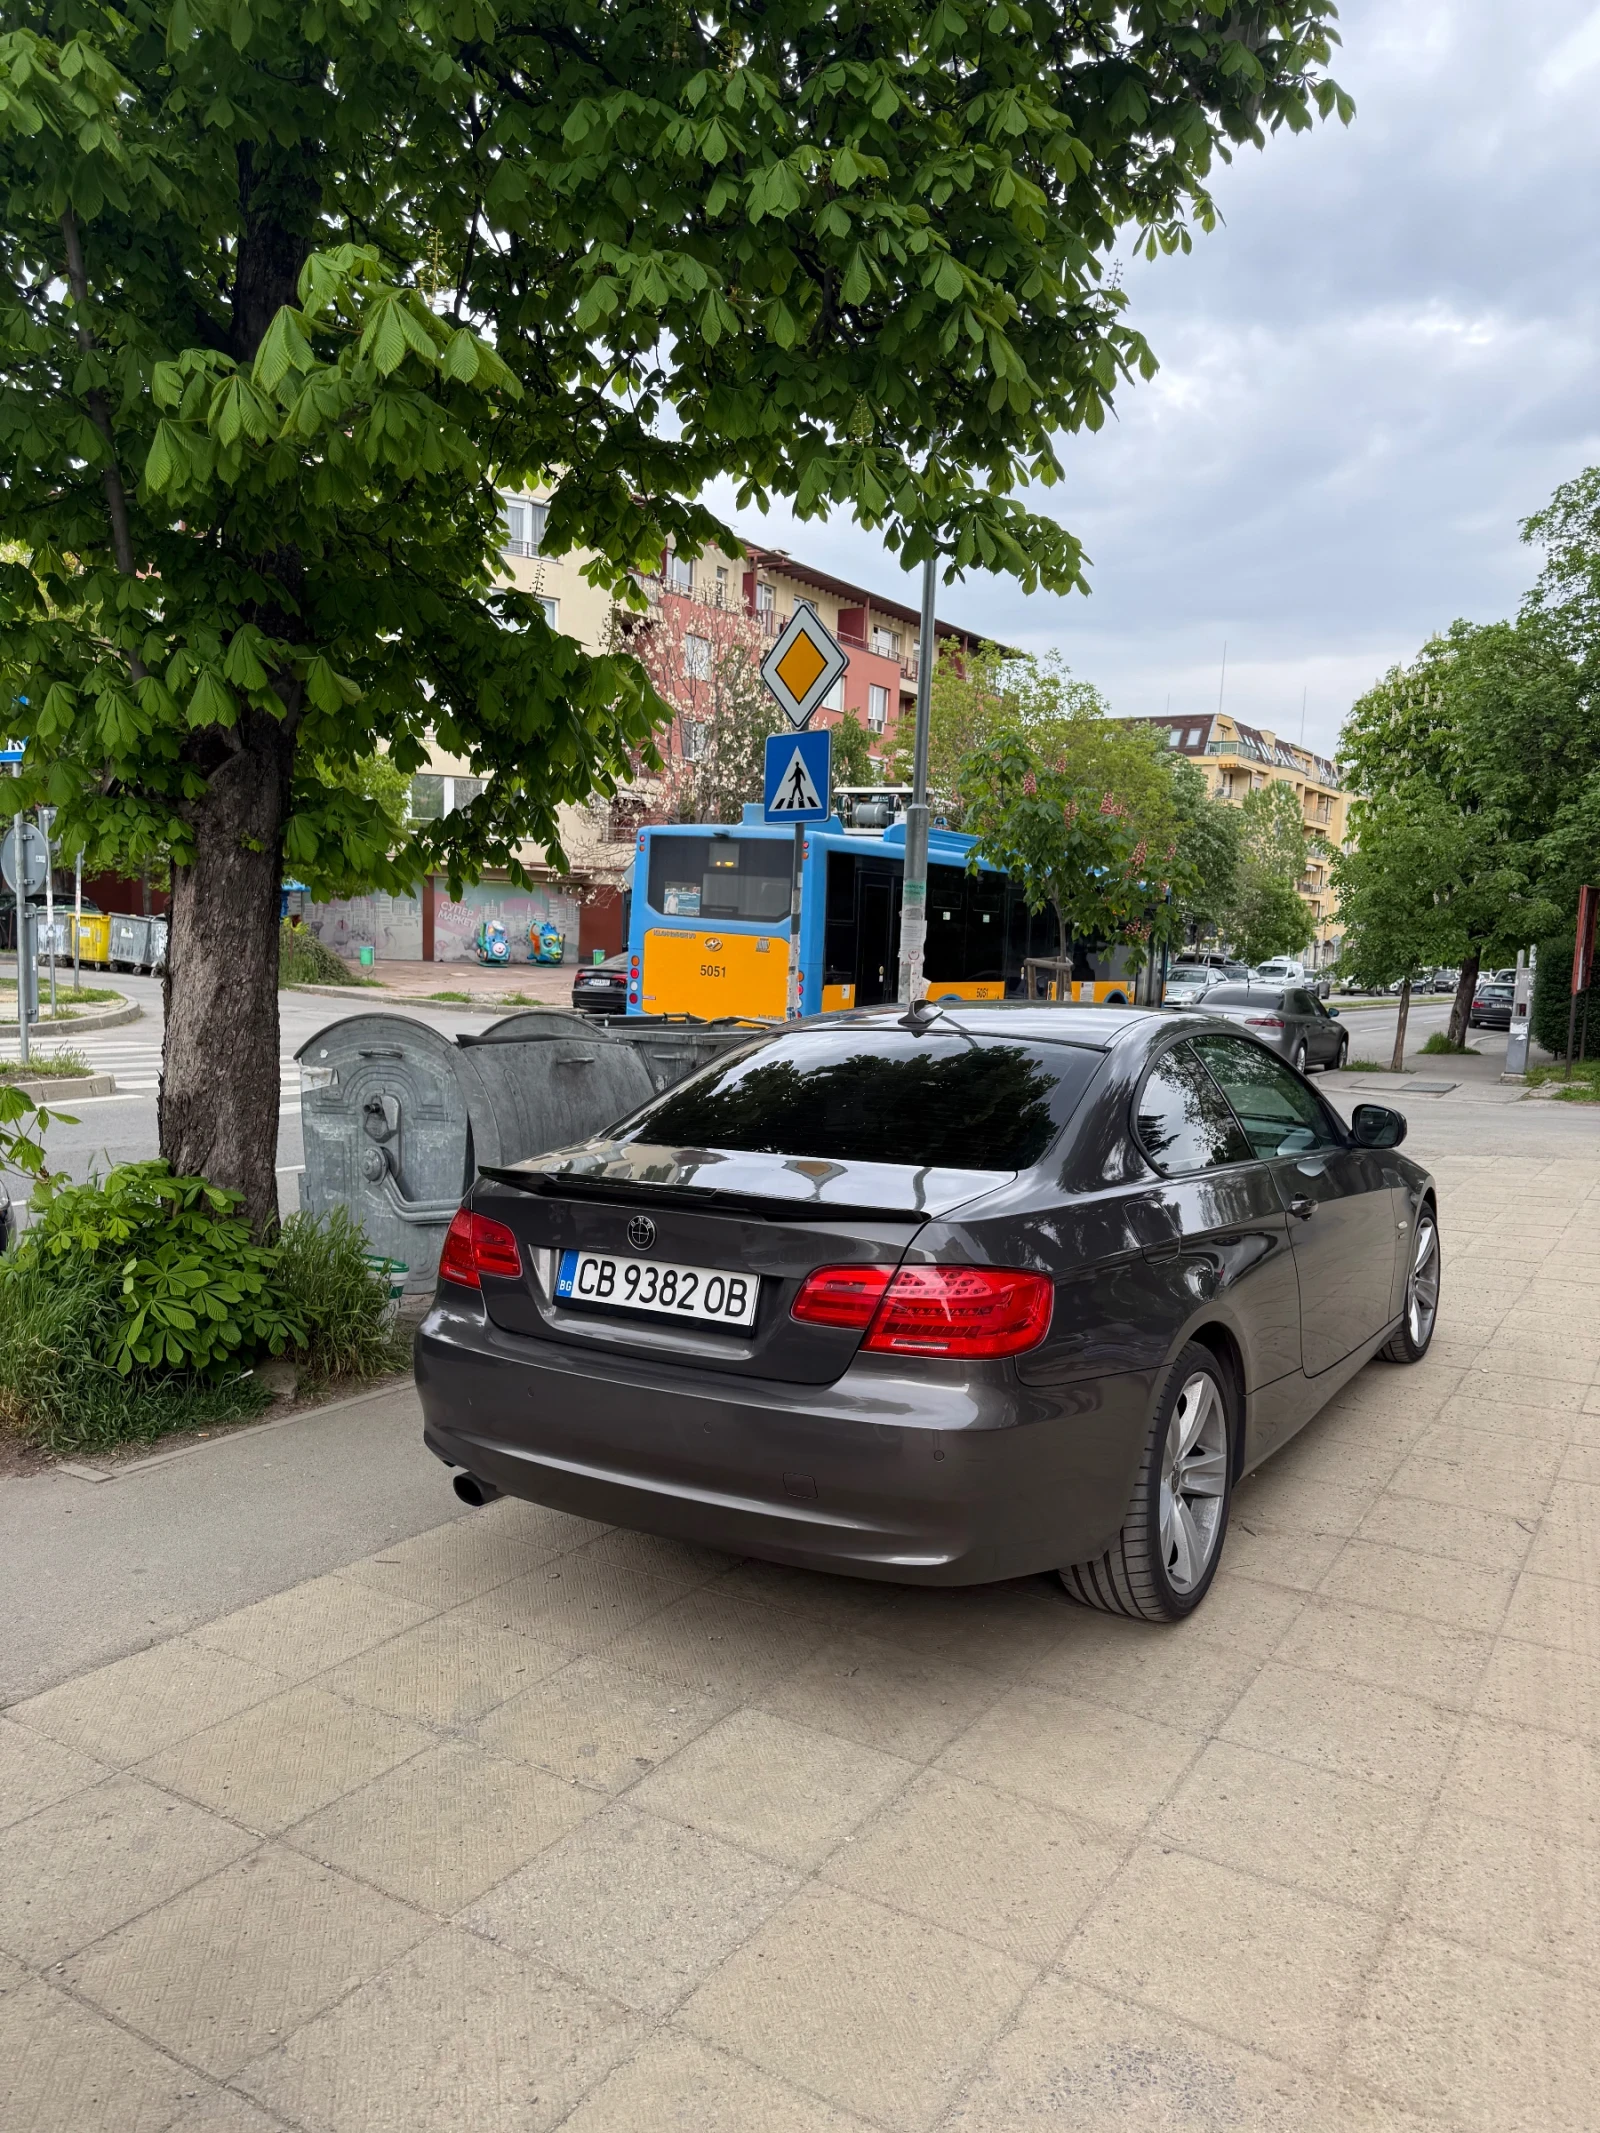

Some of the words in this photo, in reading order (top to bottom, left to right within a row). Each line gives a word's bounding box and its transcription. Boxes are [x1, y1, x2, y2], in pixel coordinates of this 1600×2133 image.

[440, 901, 474, 917] СУПЕР
[437, 909, 474, 928] МАРКЕТ
[700, 964, 726, 978] 5051
[976, 987, 989, 998] 5051
[559, 1278, 572, 1292] BG
[578, 1258, 617, 1298] CB
[624, 1264, 699, 1311] 9382
